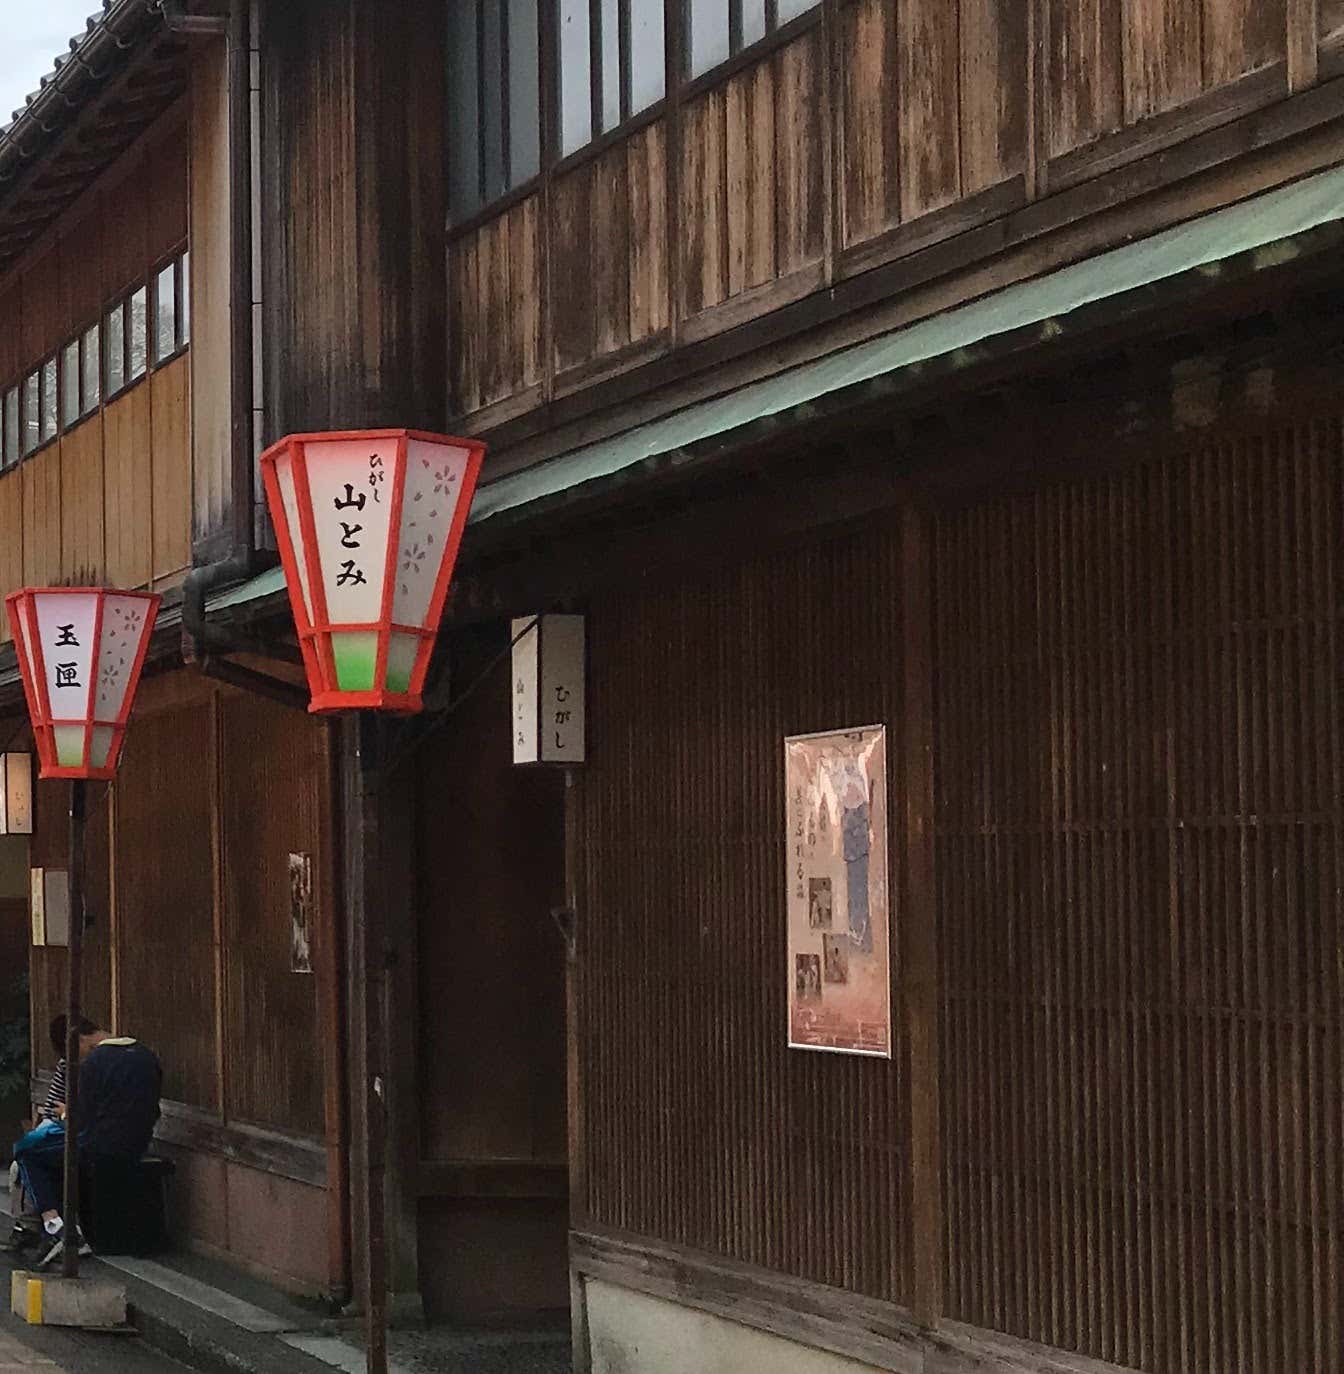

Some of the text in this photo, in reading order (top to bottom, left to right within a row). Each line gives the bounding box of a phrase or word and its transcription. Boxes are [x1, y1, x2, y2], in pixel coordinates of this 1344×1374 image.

[369, 453, 384, 503] ひがし
[334, 484, 367, 586] 山とみ
[54, 624, 81, 688] 玉匣
[555, 686, 571, 749] ひがし
